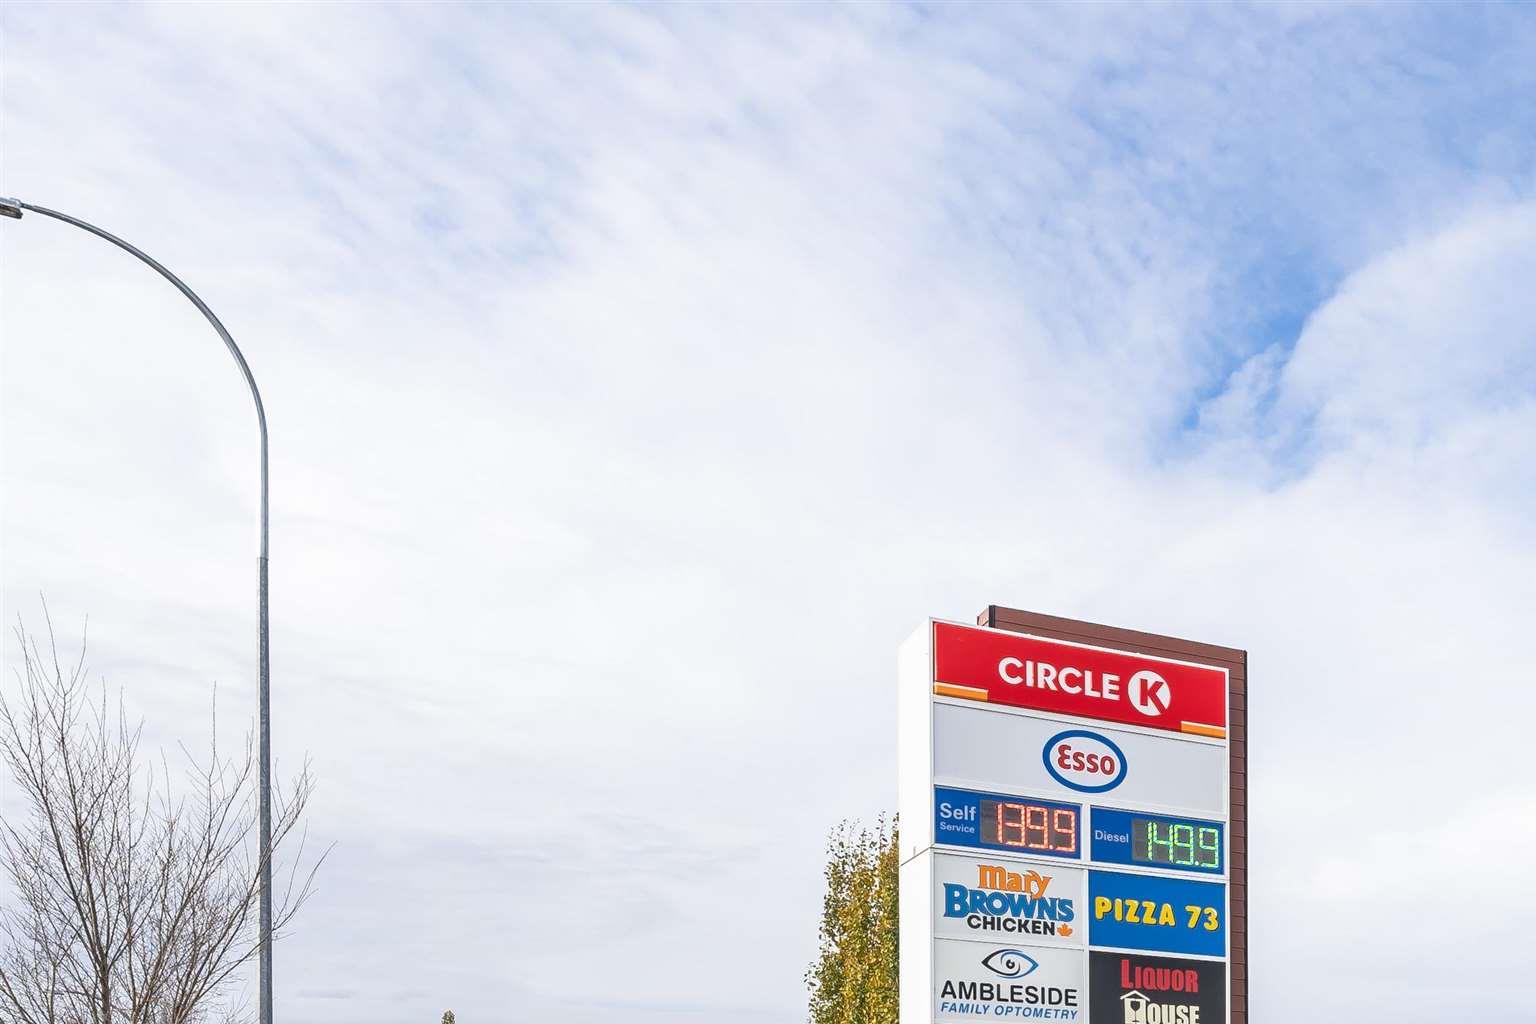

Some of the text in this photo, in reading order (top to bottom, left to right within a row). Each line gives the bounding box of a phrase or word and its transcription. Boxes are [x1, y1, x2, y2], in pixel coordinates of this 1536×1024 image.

[998, 657, 1169, 715] CIRCLE K
[940, 802, 977, 821] Self
[940, 821, 976, 834] Service
[997, 802, 1076, 852] 139.9
[1094, 829, 1129, 843] Diesel
[1147, 821, 1219, 868] 149.9
[967, 914, 1055, 936] CHICKEN
[1095, 896, 1220, 931] PIZZA 73
[1121, 959, 1199, 993] LIQUOR
[940, 980, 1078, 1007] AMBLESIDE
[940, 1001, 1078, 1020] FAMILY OPTOMETRY
